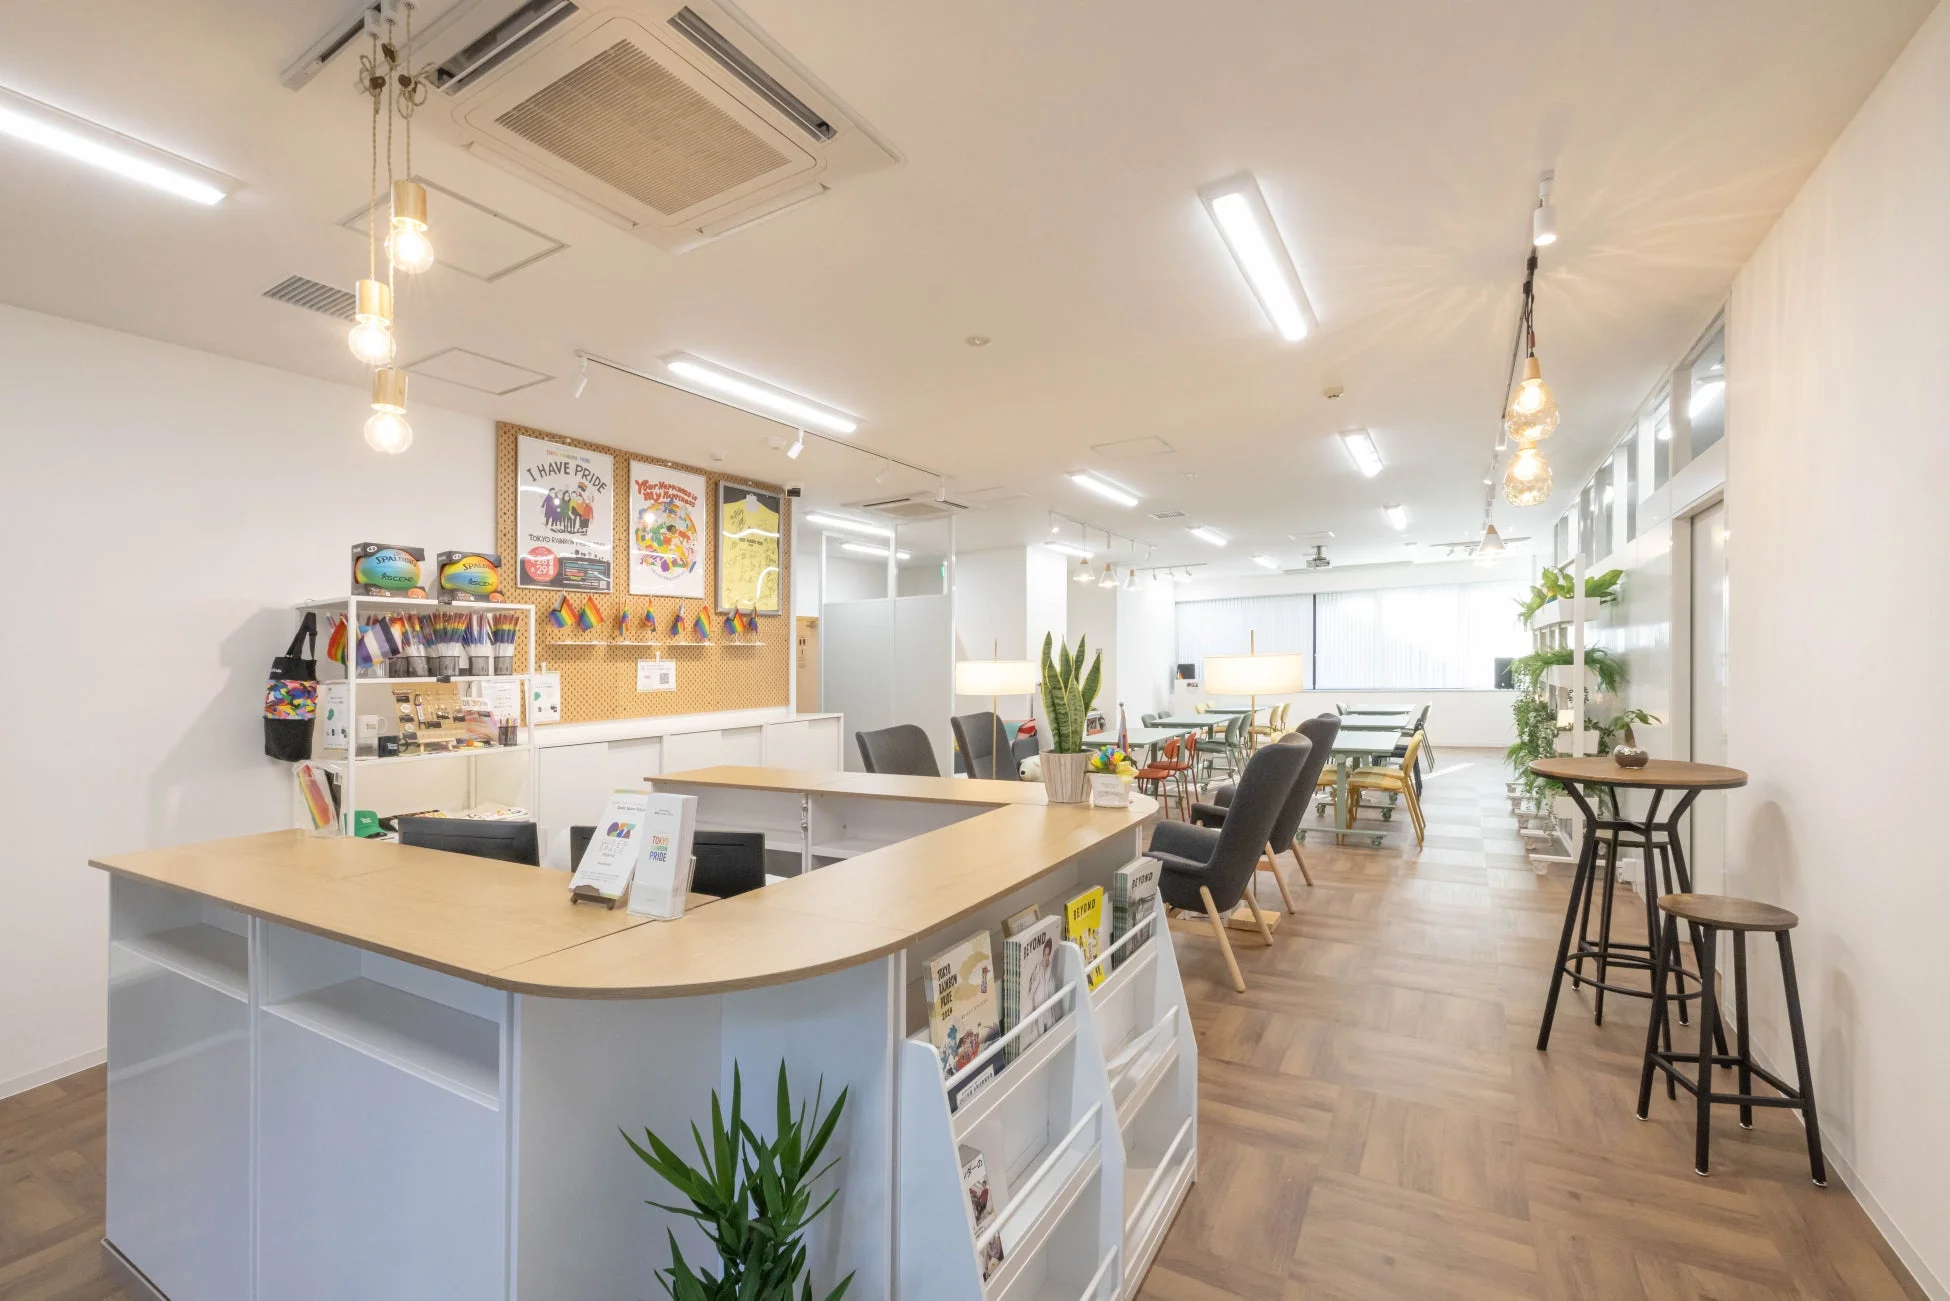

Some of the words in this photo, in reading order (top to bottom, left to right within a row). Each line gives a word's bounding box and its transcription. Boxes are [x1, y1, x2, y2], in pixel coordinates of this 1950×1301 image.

[526, 468, 537, 482] I
[537, 461, 570, 478] HAVE
[574, 464, 607, 494] PRIDE
[528, 534, 550, 543] TOKYO
[376, 555, 417, 567] SPALDING
[381, 572, 414, 582] ASCEND
[652, 835, 669, 845] TOKYO
[649, 850, 667, 862] PRIDE
[1132, 872, 1153, 889] BEYOND
[1073, 899, 1096, 920] BEYOND
[1023, 932, 1046, 960] BEYOND
